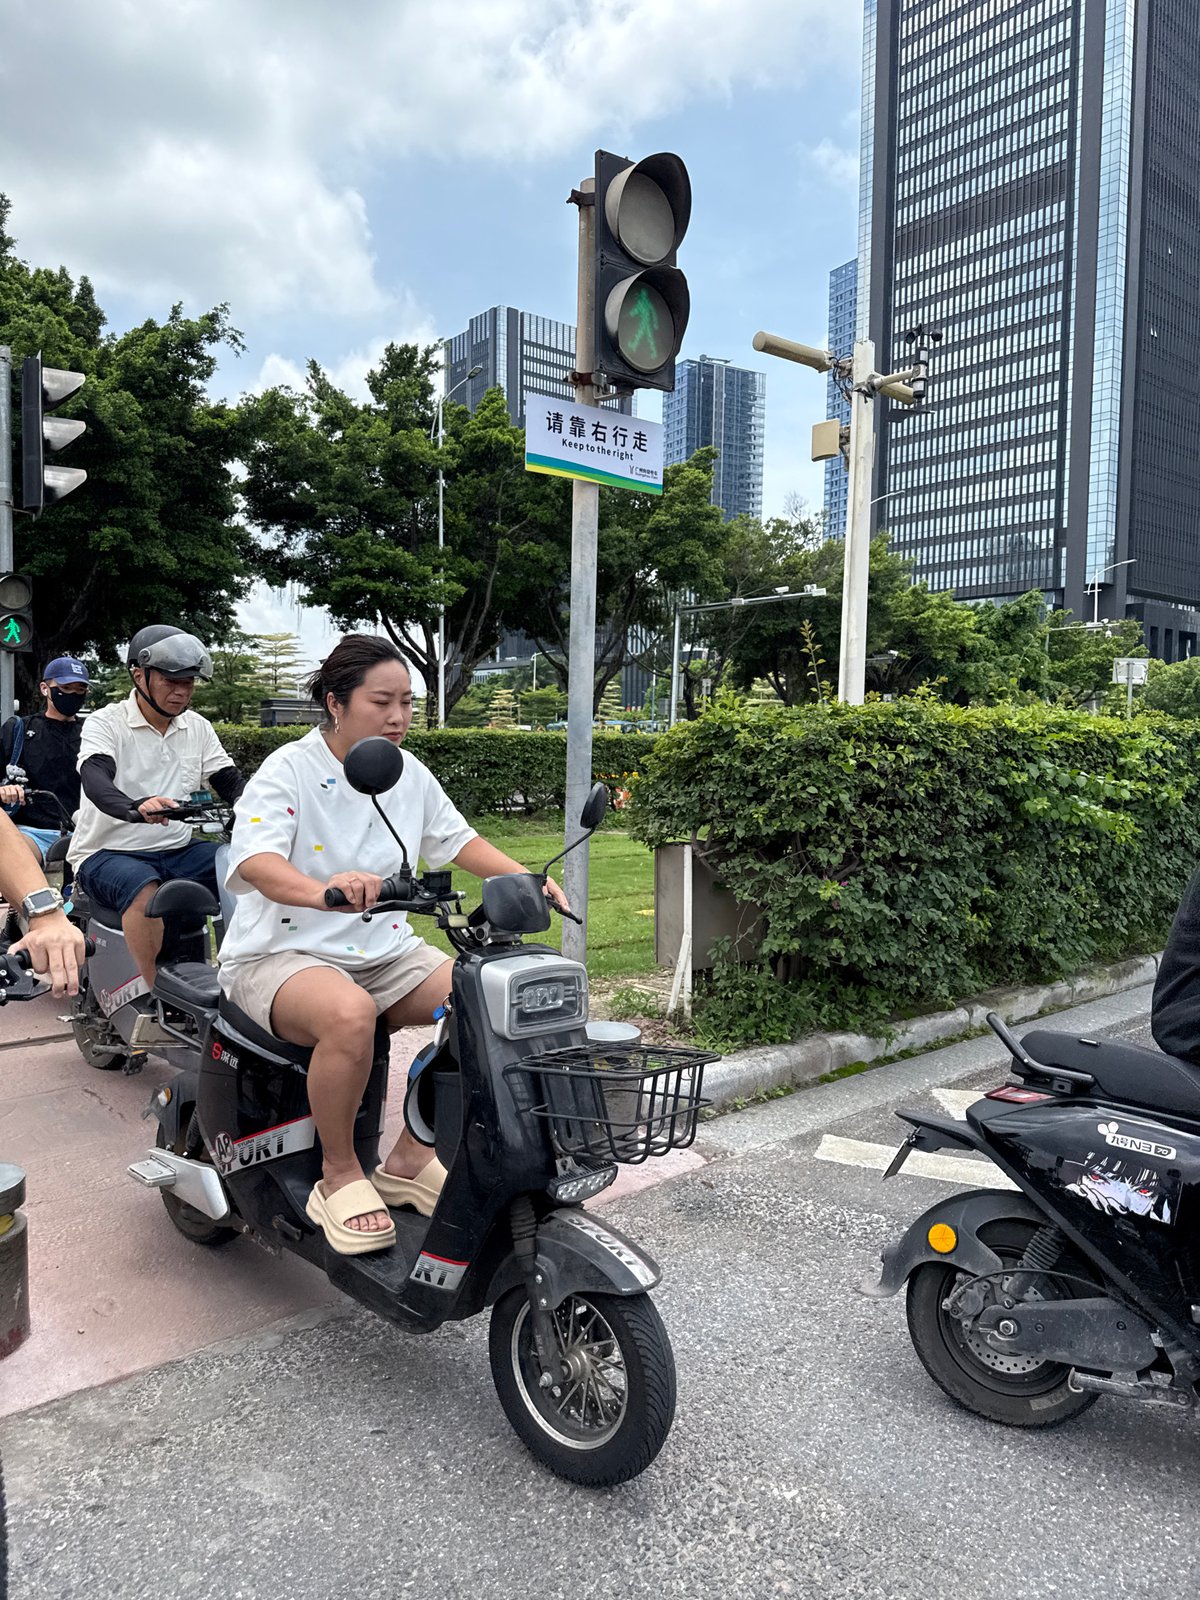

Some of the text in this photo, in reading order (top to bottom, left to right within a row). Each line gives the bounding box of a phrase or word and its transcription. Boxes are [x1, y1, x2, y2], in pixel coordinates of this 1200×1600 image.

[546, 410, 648, 453] 请靠右行走
[562, 438, 634, 461] Keep to the right
